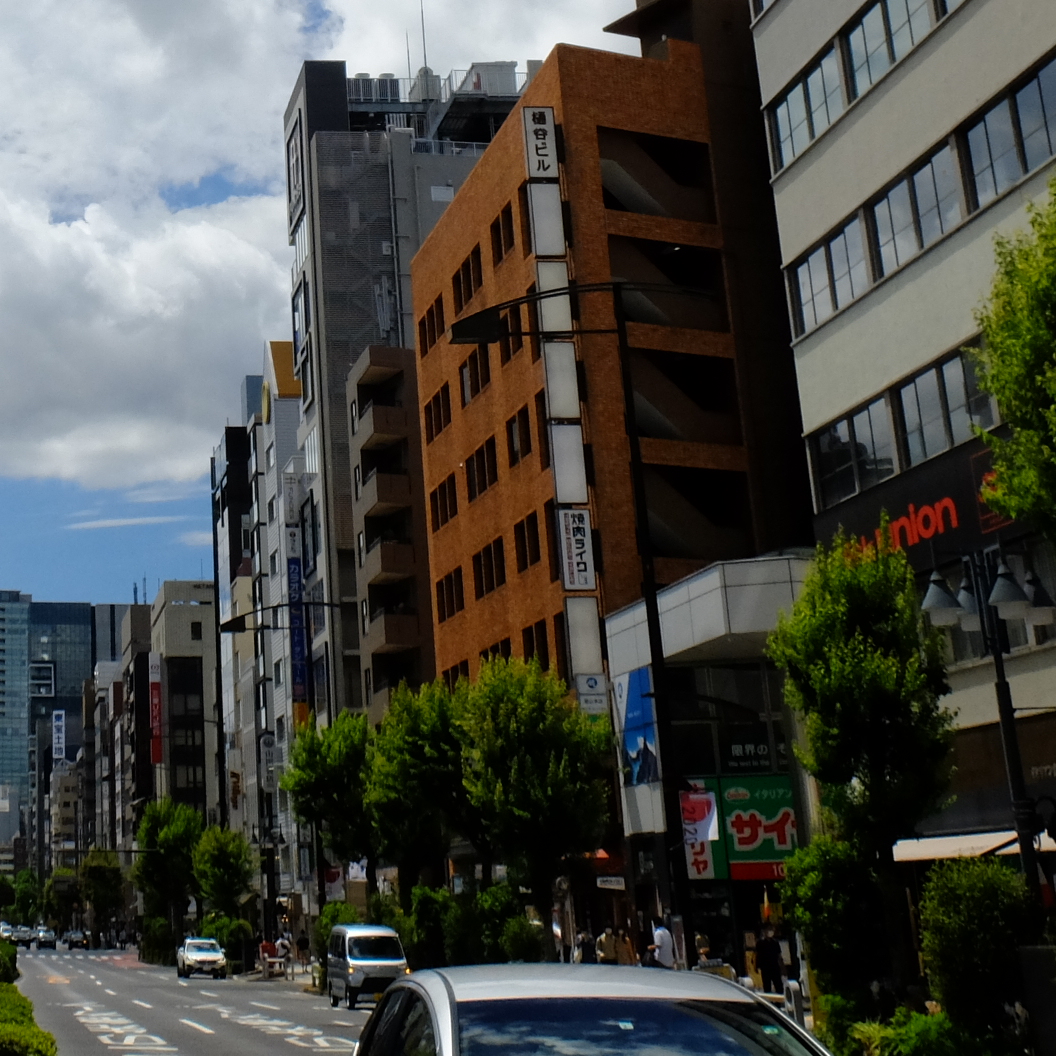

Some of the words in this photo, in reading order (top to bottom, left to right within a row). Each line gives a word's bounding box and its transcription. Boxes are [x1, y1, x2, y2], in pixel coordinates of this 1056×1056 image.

[571, 512, 587, 573] 焼肉ライク
[289, 563, 301, 603] カラオケ
[730, 809, 798, 846] サイ
